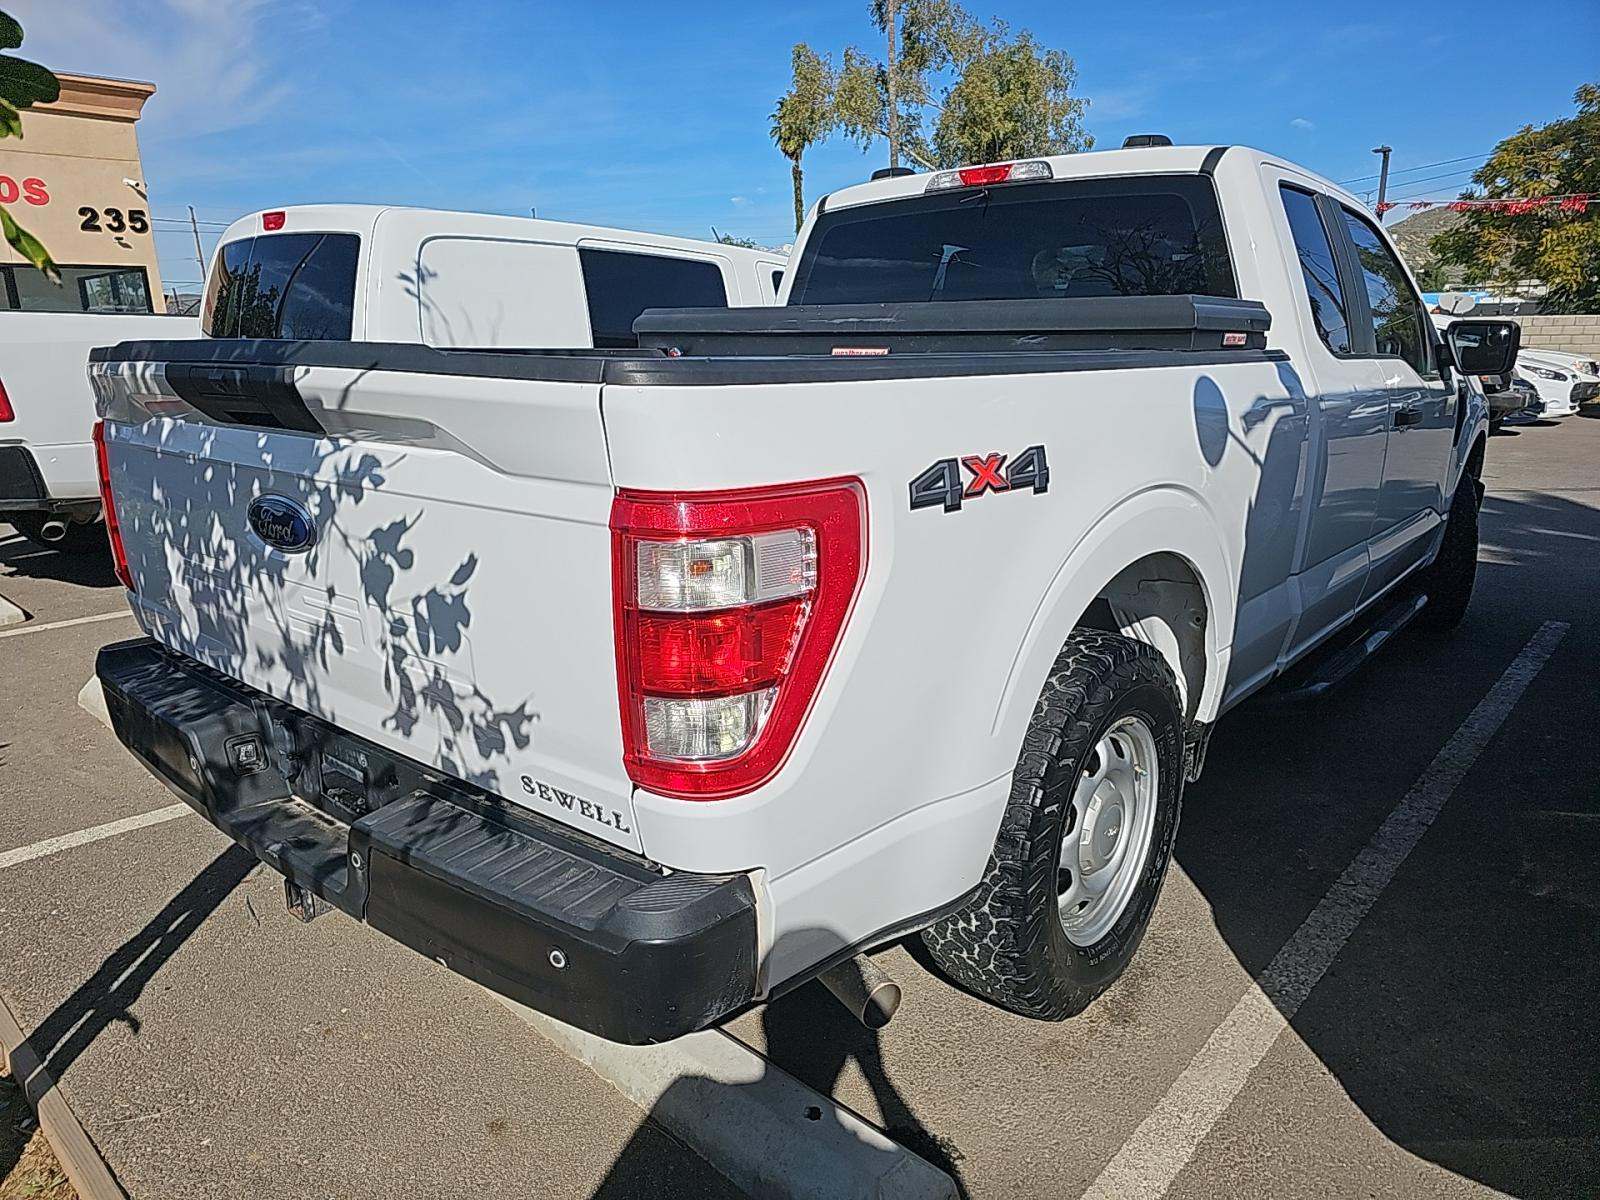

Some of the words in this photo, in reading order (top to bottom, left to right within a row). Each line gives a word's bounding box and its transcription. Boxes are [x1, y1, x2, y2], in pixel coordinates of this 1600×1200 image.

[78, 207, 149, 234] 235
[258, 506, 294, 543] Ford
[520, 775, 630, 834] SEWELL
